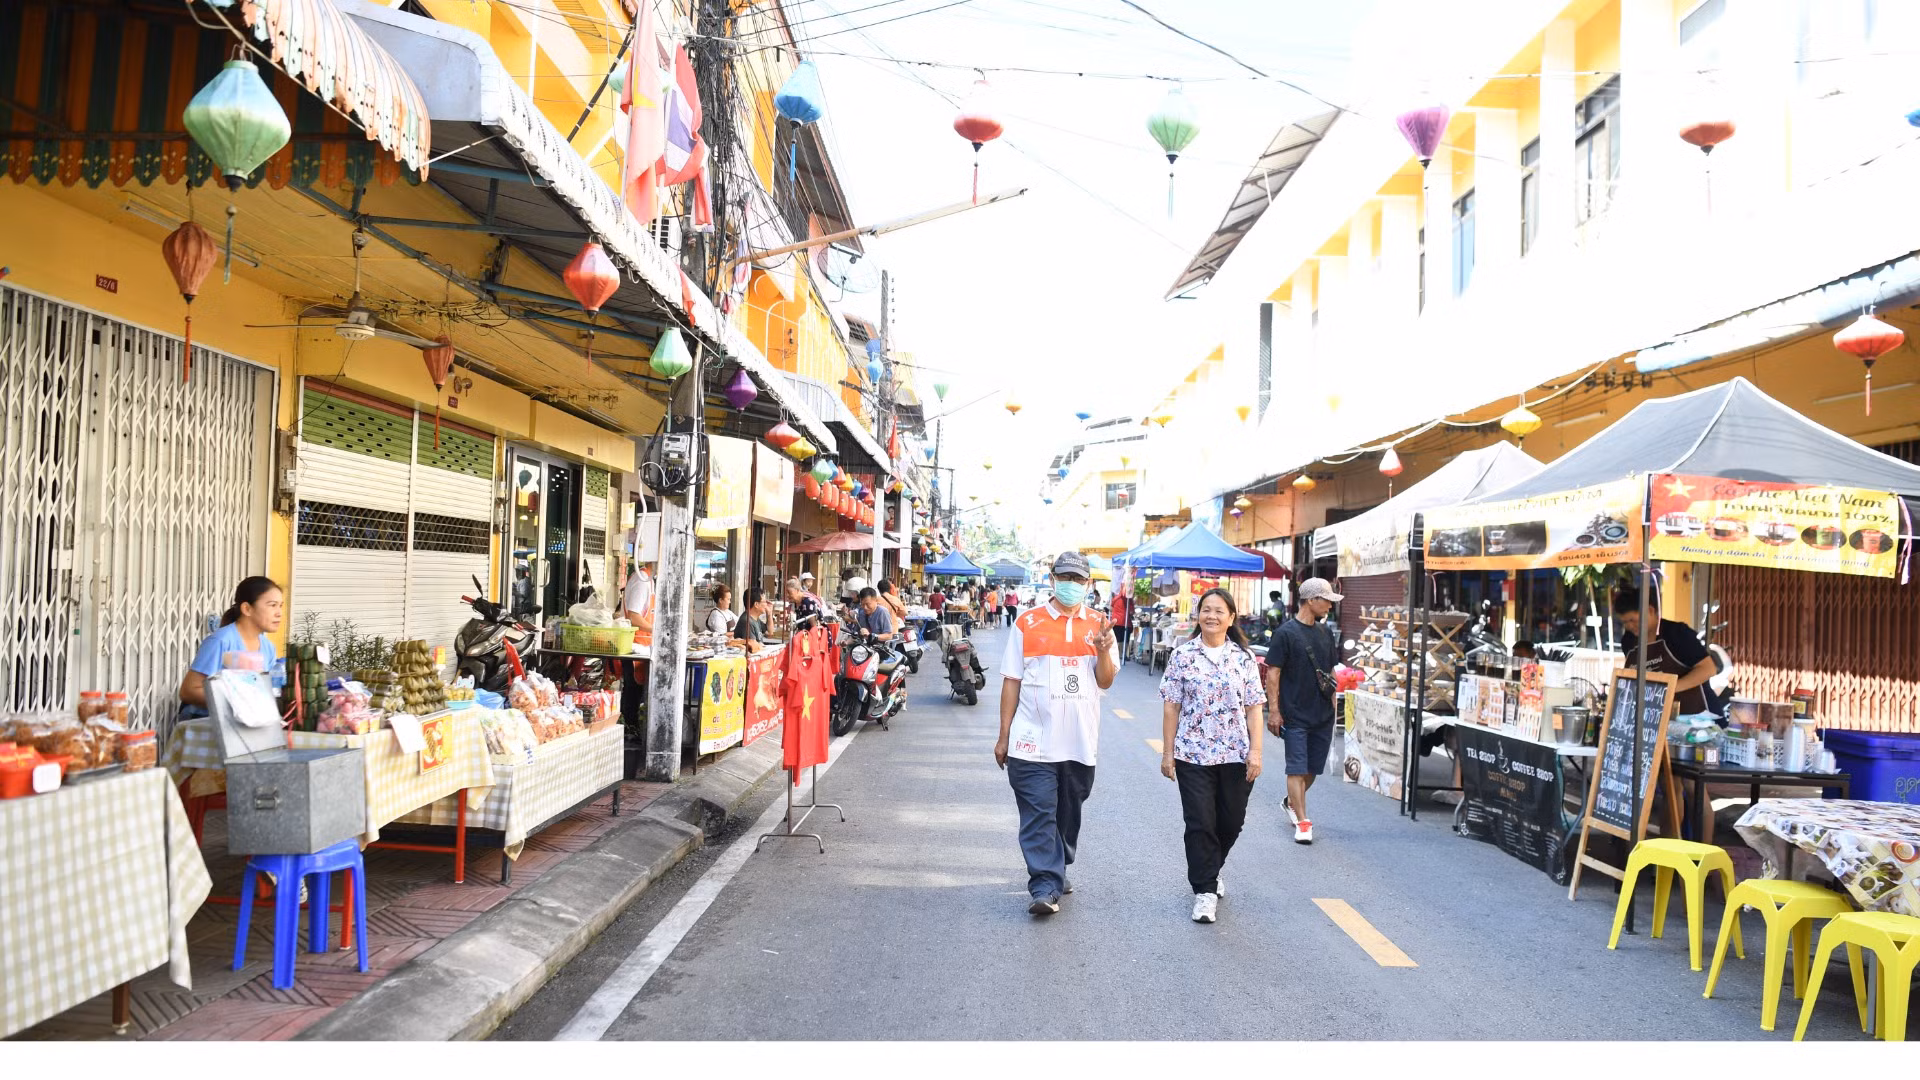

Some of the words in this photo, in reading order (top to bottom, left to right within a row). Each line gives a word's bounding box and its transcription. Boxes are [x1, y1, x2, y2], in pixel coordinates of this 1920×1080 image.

[1833, 491, 1884, 510] Nam
[1062, 659, 1078, 667] LEO
[1466, 747, 1479, 758] TEA
[1479, 750, 1496, 764] SHOP
[1511, 761, 1535, 777] COFFEE
[1536, 767, 1554, 782] SHOP
